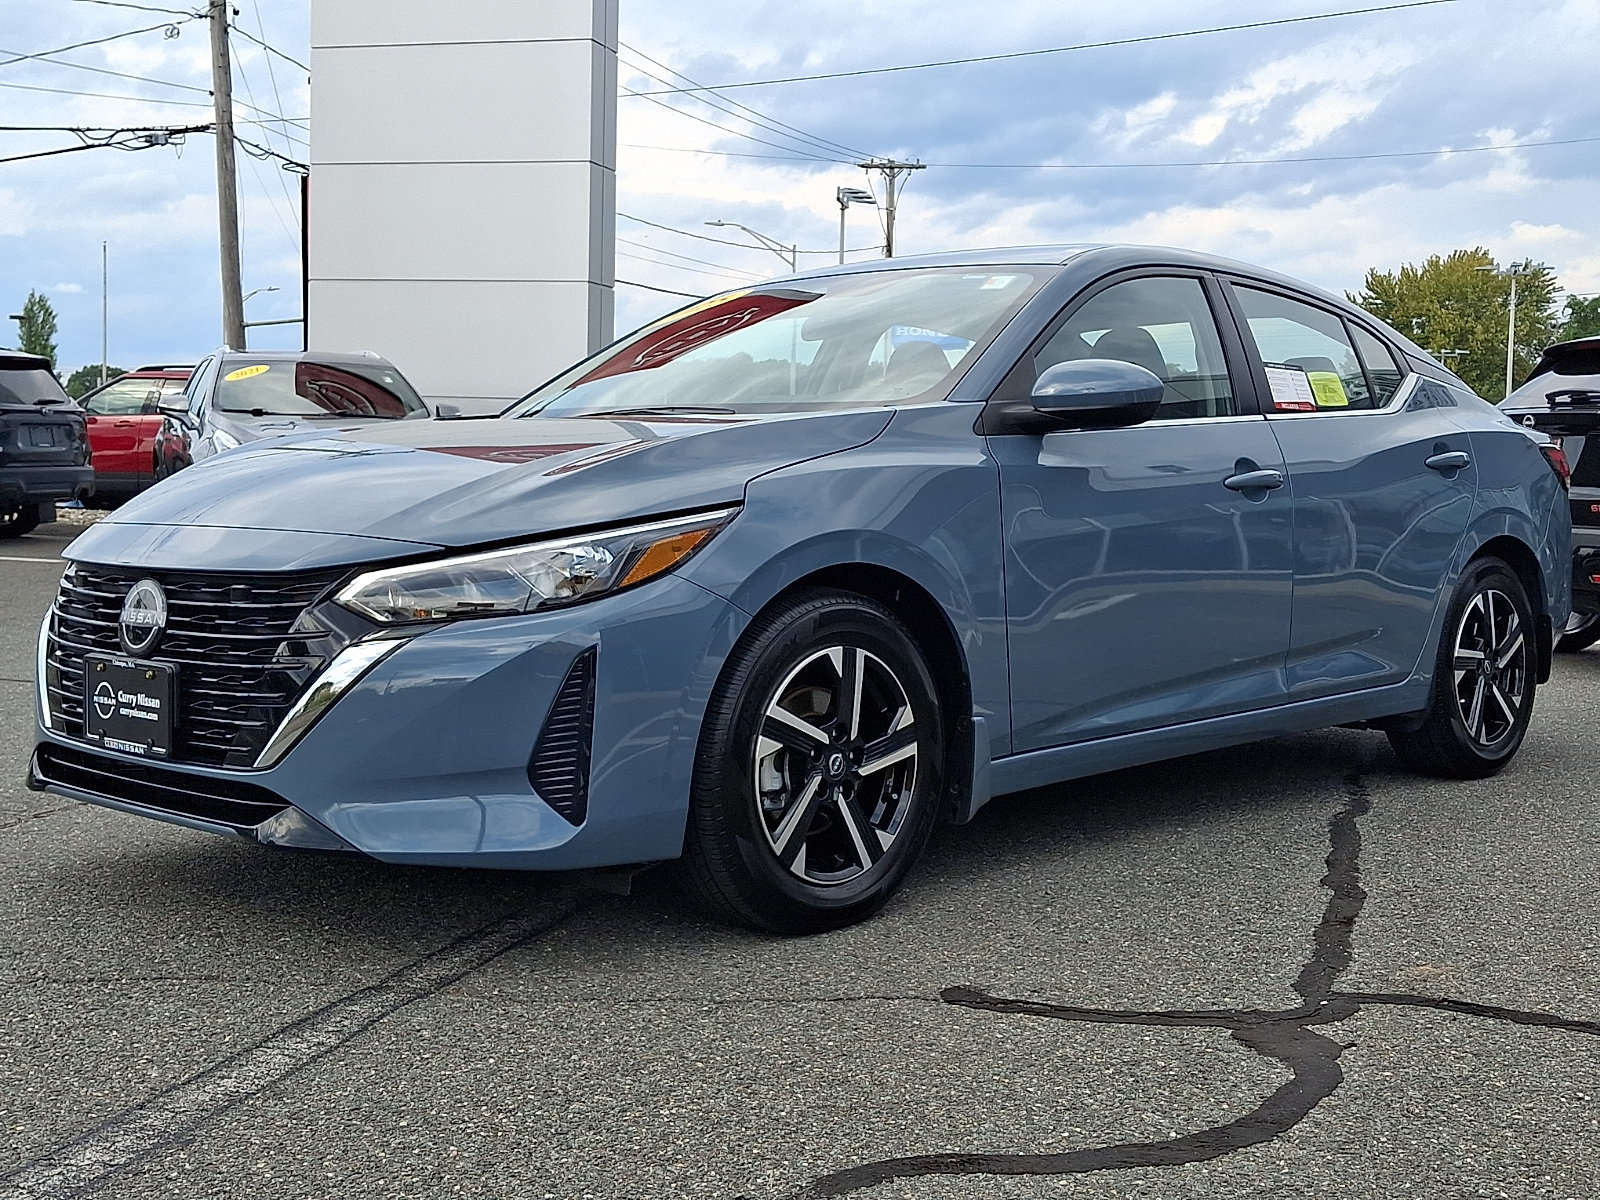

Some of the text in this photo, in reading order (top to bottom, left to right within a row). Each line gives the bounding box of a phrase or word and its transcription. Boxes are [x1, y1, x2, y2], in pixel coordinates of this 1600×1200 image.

[235, 366, 259, 379] 2021
[120, 610, 165, 627] NISSAN
[93, 695, 116, 706] NISSAN
[117, 690, 161, 709] Curry Nissan
